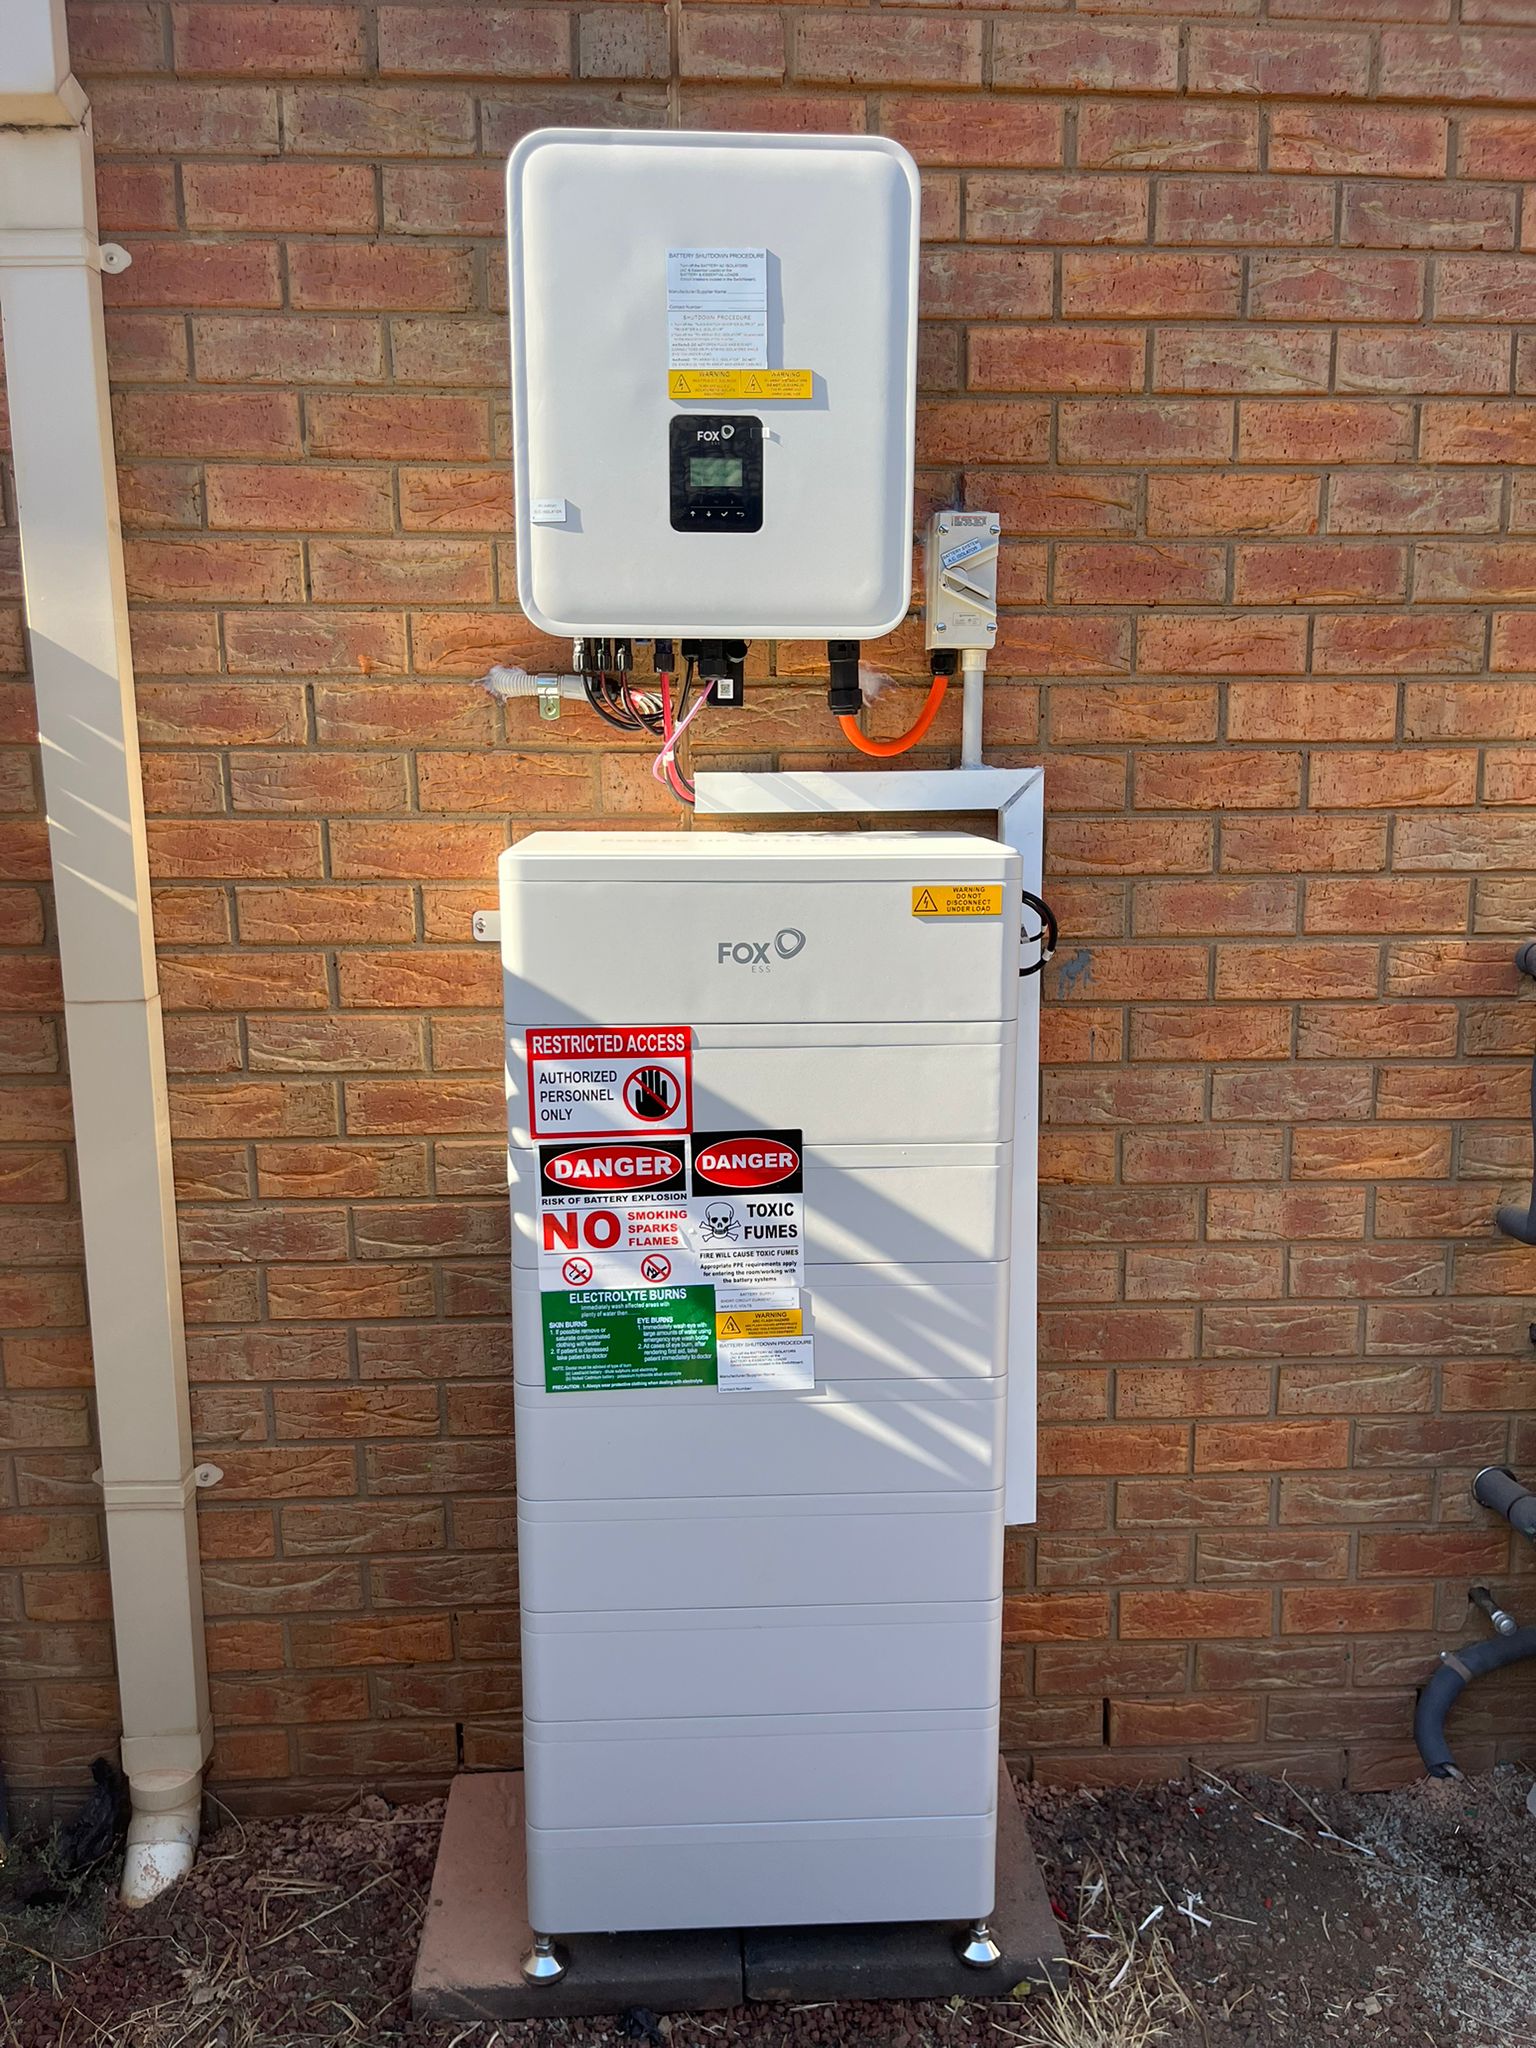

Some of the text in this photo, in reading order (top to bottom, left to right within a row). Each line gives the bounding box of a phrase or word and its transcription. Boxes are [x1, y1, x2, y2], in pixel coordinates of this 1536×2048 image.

[697, 431, 720, 441] FOX
[943, 548, 961, 559] BATTERY
[718, 943, 770, 964] FOX
[532, 1034, 685, 1054] RESTRICTED ACCESS
[539, 1070, 617, 1084] AUTHORIZED
[540, 1089, 614, 1102] PERSONNEL
[541, 1108, 573, 1121] ONLY
[554, 1156, 673, 1179] DANGER
[702, 1152, 793, 1170] DANGER
[584, 1195, 629, 1204] BATTERY
[632, 1193, 687, 1202] EXPLOSION
[628, 1210, 687, 1220] SMOKING
[747, 1203, 794, 1218] TOXIC
[542, 1210, 621, 1250] NO
[628, 1223, 678, 1233] SPARKS
[744, 1224, 798, 1240] FUMES
[629, 1236, 678, 1246] FLAMES
[570, 1288, 687, 1304] ELECTROLYTE BURNS
